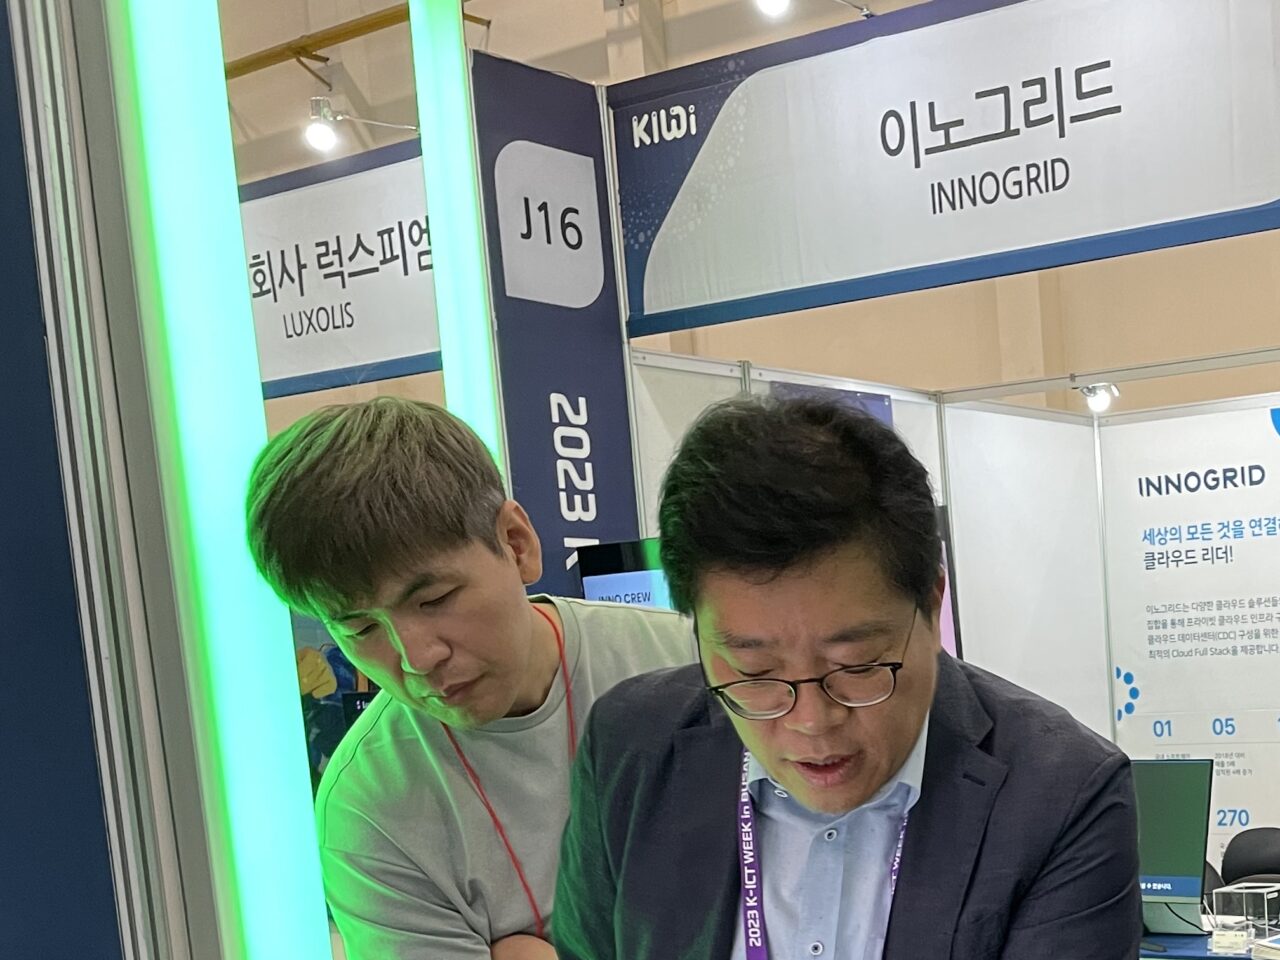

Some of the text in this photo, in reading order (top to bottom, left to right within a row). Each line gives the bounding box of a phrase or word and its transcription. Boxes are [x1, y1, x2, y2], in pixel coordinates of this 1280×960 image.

[879, 59, 1123, 168] 이노그리드
[930, 157, 1072, 215] INNOGRID
[520, 197, 583, 251] J16
[249, 244, 307, 303] 회사
[283, 302, 354, 338] LUXOLIS
[550, 392, 598, 522] 2023
[1138, 464, 1266, 497] INNOGRID
[1142, 526, 1183, 546] 세상의
[1186, 522, 1213, 541] 모든
[1217, 519, 1245, 540] 것을
[1143, 545, 1233, 571] 클라우드 리더!
[624, 591, 651, 604] CREW
[1146, 602, 1190, 615] 이노그리드는
[1192, 600, 1214, 612] 다양한
[1216, 598, 1245, 611] 클라우드
[1218, 614, 1248, 626] 클라우드
[1250, 612, 1274, 624] 인프라
[1147, 633, 1177, 645] 클라우드
[1238, 628, 1261, 640] 구성을
[1172, 648, 1193, 658] Cloud
[1194, 646, 1208, 657] Full
[1153, 719, 1172, 738] 01
[1212, 717, 1236, 736] 05
[1216, 809, 1250, 827] 270
[741, 822, 755, 864] WEEK
[744, 866, 757, 906] K-ICT
[748, 910, 762, 947] 2023
